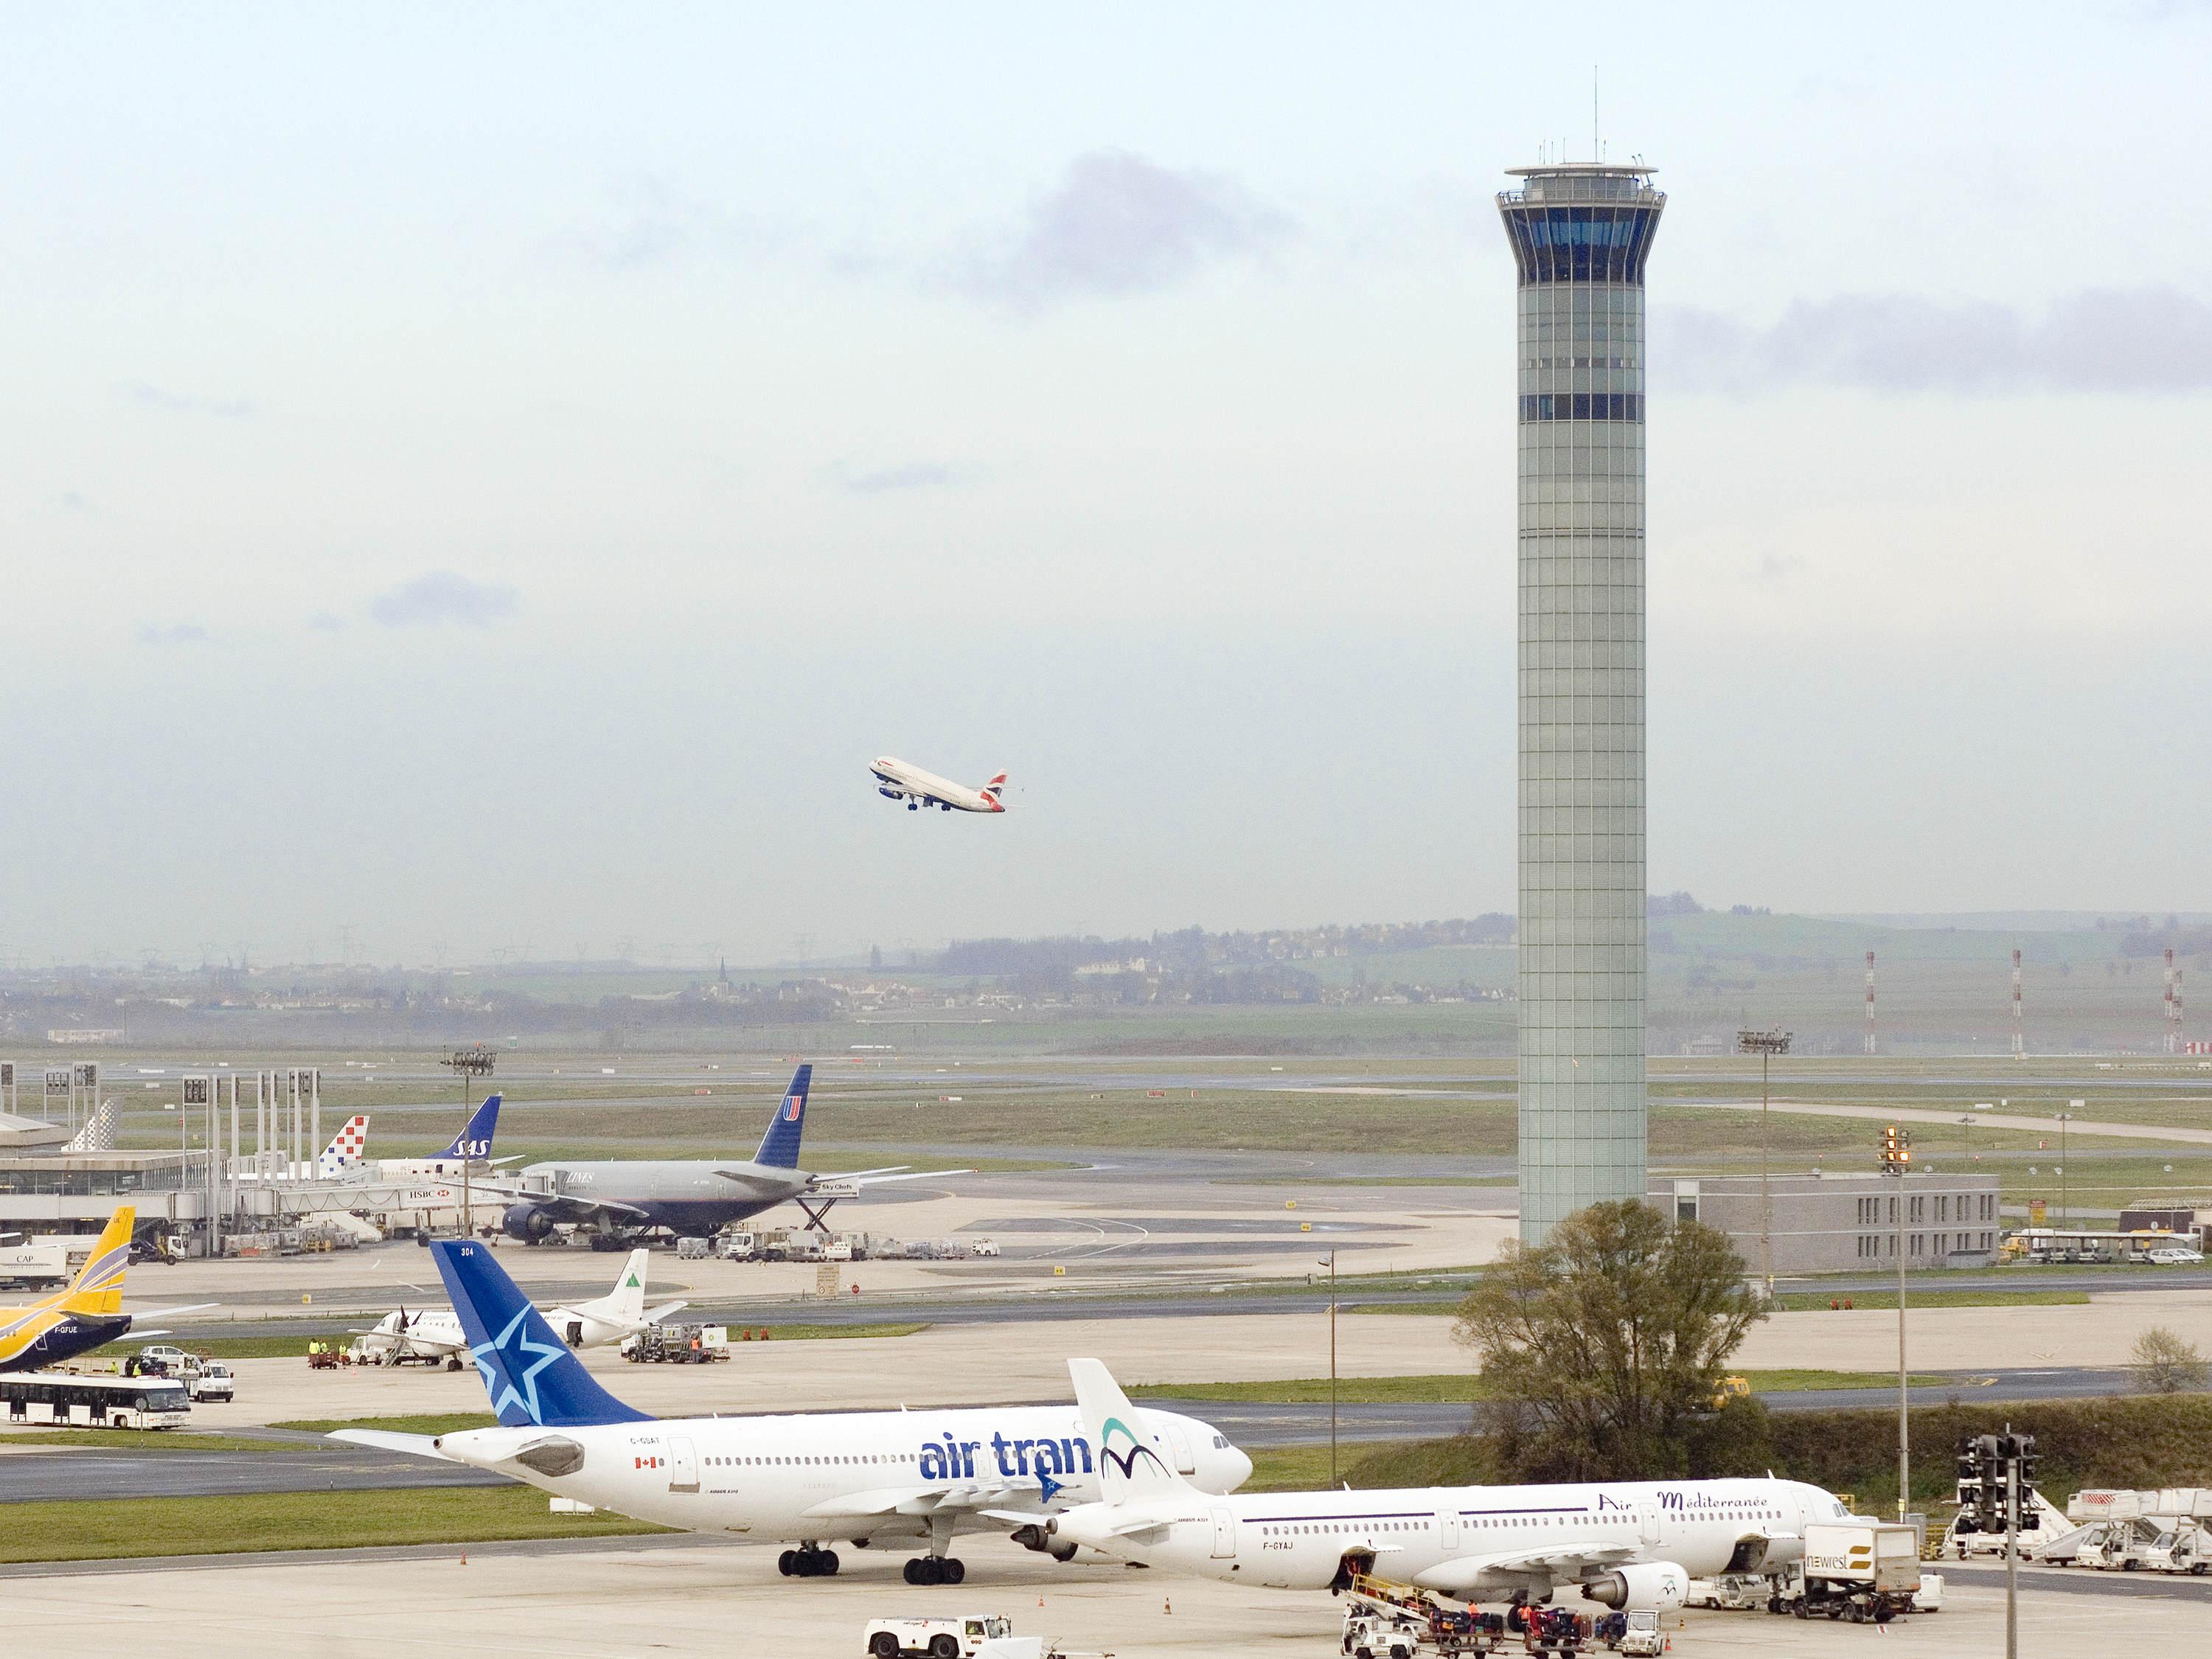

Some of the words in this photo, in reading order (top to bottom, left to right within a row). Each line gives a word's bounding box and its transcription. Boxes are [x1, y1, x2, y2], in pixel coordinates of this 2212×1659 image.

[453, 1140, 490, 1156] SAS
[410, 1190, 435, 1199] HSBC
[461, 1248, 473, 1256] 304
[630, 1437, 661, 1445] C-GSAT
[919, 1431, 981, 1480] air
[991, 1431, 1094, 1477] tran
[1599, 1493, 1632, 1511] Air
[1657, 1492, 1768, 1511] Méditerranée
[1263, 1542, 1293, 1551] F-GYAJ
